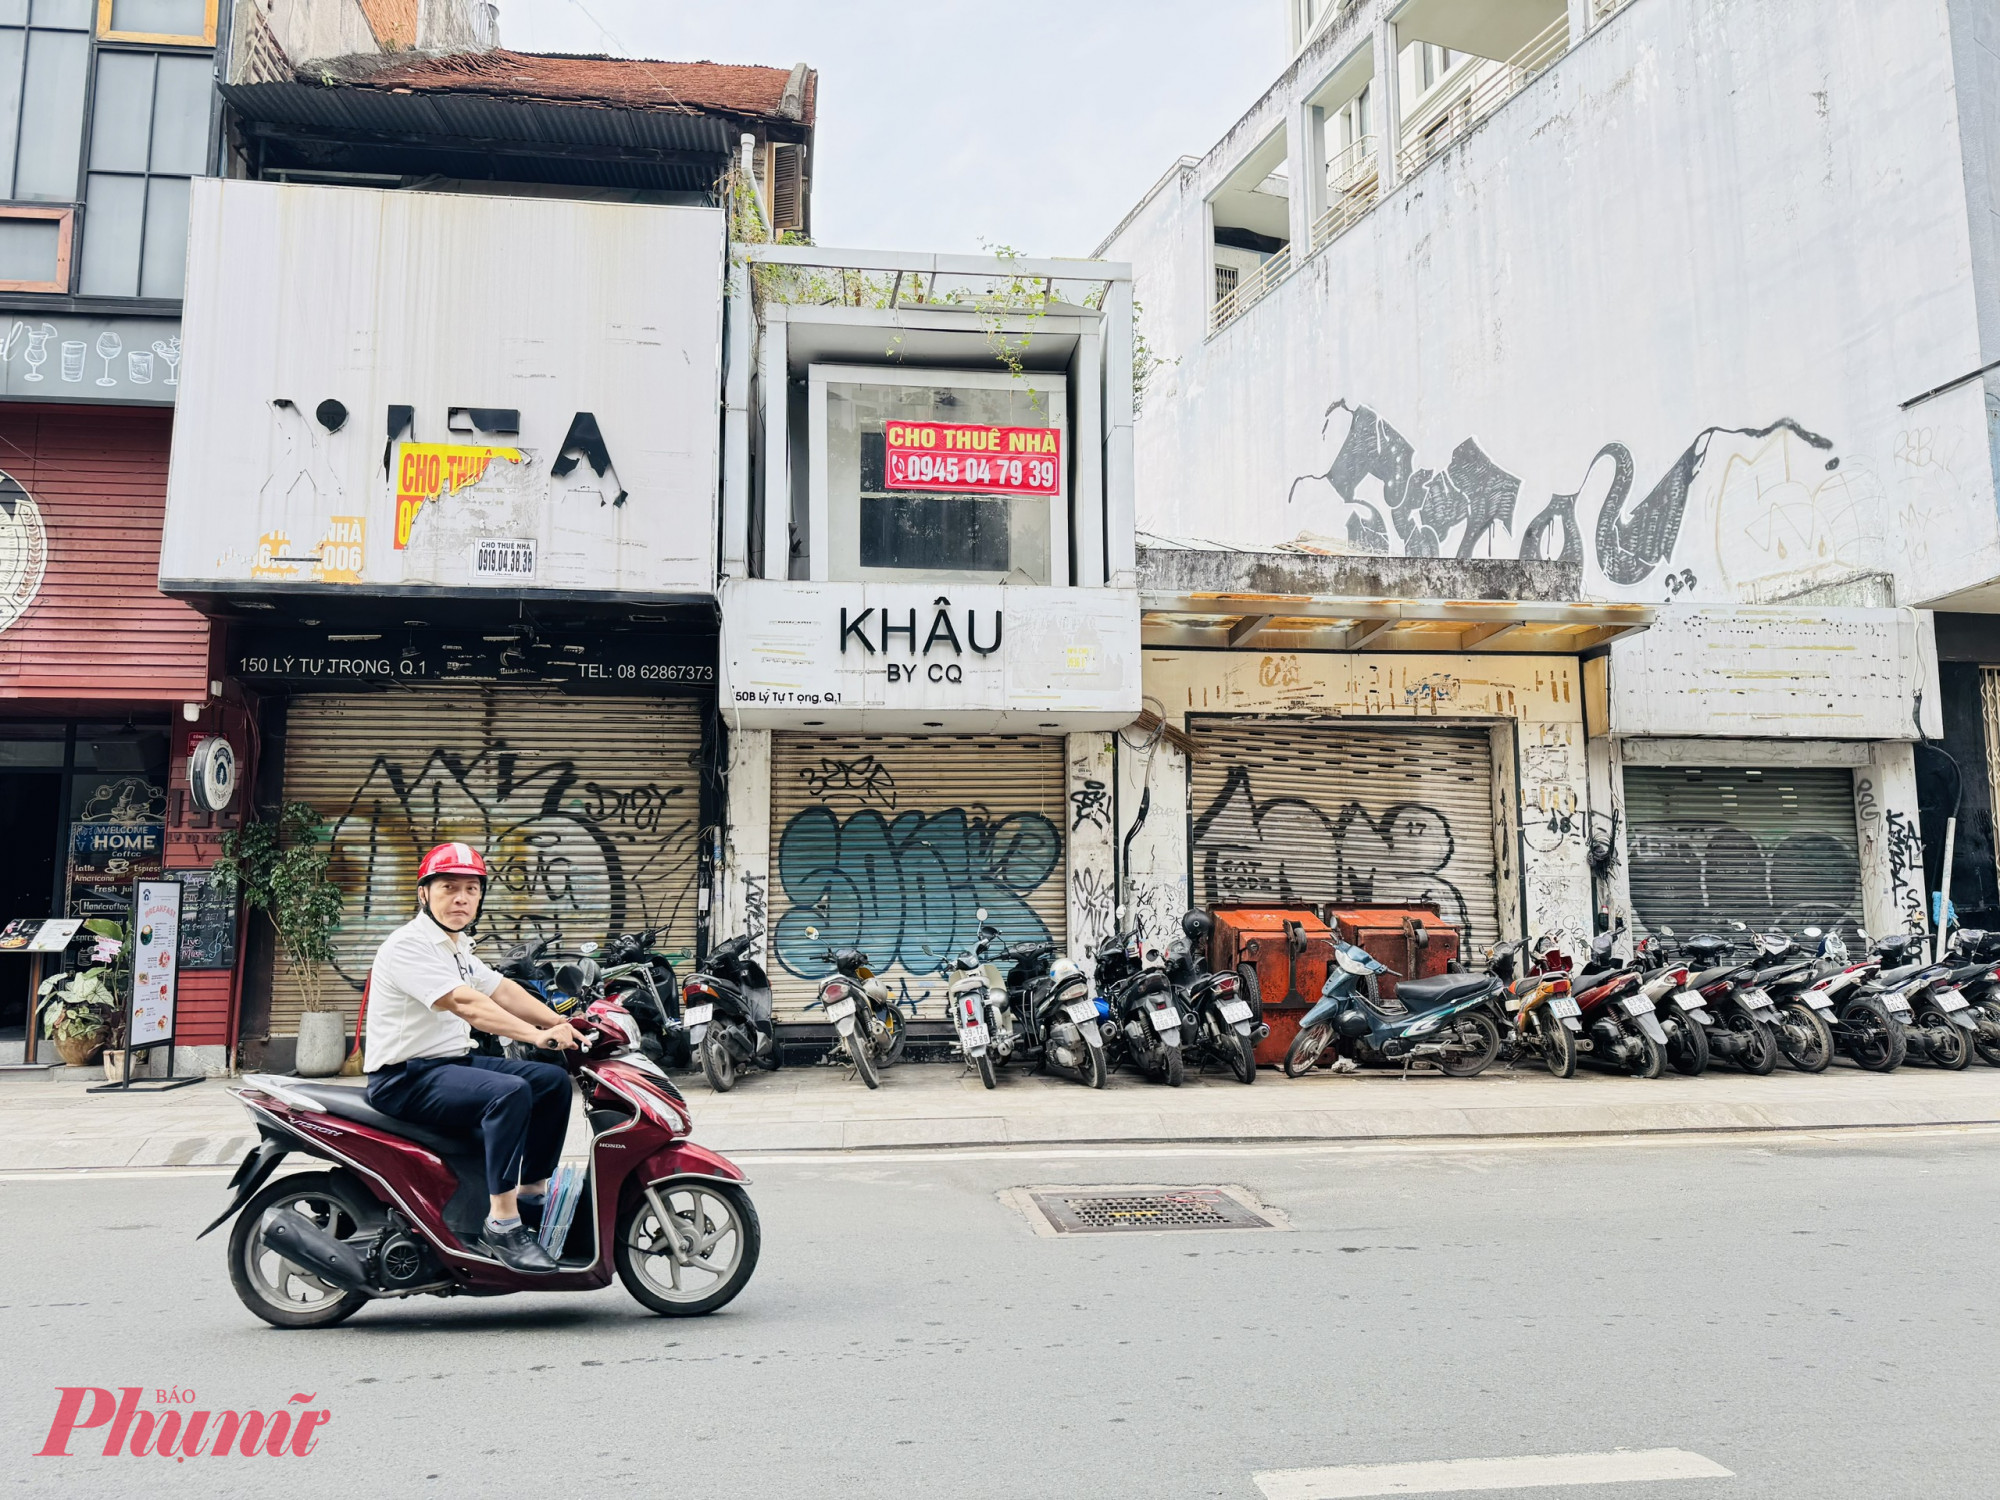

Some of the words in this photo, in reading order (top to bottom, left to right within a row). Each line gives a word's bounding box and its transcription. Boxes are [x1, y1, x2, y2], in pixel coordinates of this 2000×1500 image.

[889, 427, 936, 448] CHO
[943, 428, 1001, 451] THUÊ
[1009, 430, 1057, 453] NHÀ
[402, 453, 440, 493] CHO
[907, 455, 959, 483] 0945
[965, 458, 991, 484] 04
[997, 459, 1023, 486] 79
[1028, 460, 1055, 488] 39
[481, 541, 496, 549] CHO
[478, 549, 533, 573] 0919.04.38.38
[840, 597, 1003, 656] KHÂU
[240, 657, 269, 672] 150
[273, 655, 294, 673] LÝ
[299, 658, 324, 676] TỰ
[400, 660, 426, 675] Q.1
[578, 663, 612, 678] TEL:
[617, 664, 636, 679] 08
[640, 664, 713, 680] 62867373
[887, 664, 917, 683] BY
[927, 664, 963, 683] CQ
[759, 691, 770, 704] Lý
[97, 826, 148, 834] WELCOME
[1408, 821, 1427, 835] 17
[1547, 816, 1571, 834] 48
[94, 835, 156, 848] HOME
[134, 865, 161, 873] Espress
[94, 885, 117, 893] Fresh
[121, 885, 133, 895] jui
[83, 901, 129, 910] Handcrafted
[145, 905, 176, 918] BREAKFAST
[288, 1115, 343, 1137] VISION
